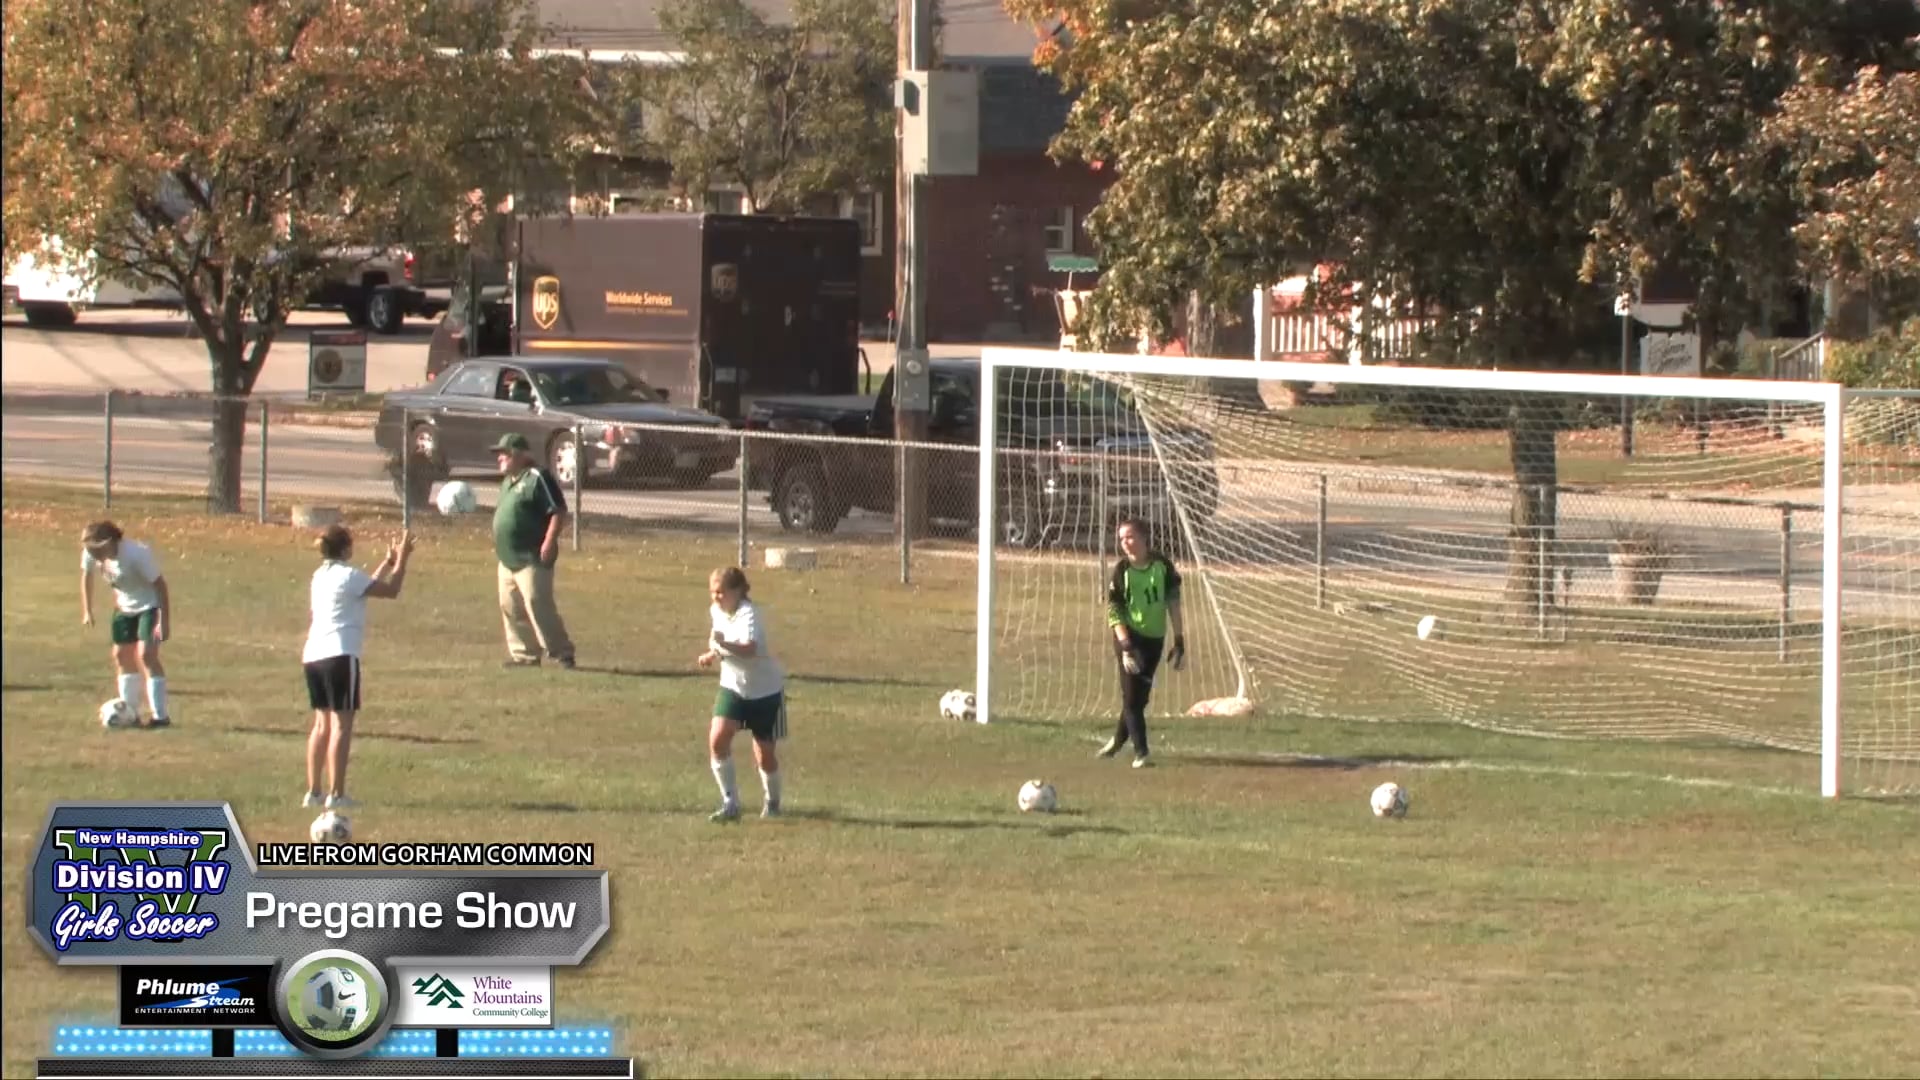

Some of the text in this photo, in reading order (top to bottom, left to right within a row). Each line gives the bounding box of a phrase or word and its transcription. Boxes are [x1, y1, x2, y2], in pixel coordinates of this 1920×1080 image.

[534, 292, 558, 322] ups
[606, 290, 673, 307] Worldwide Services
[1143, 585, 1159, 605] 11
